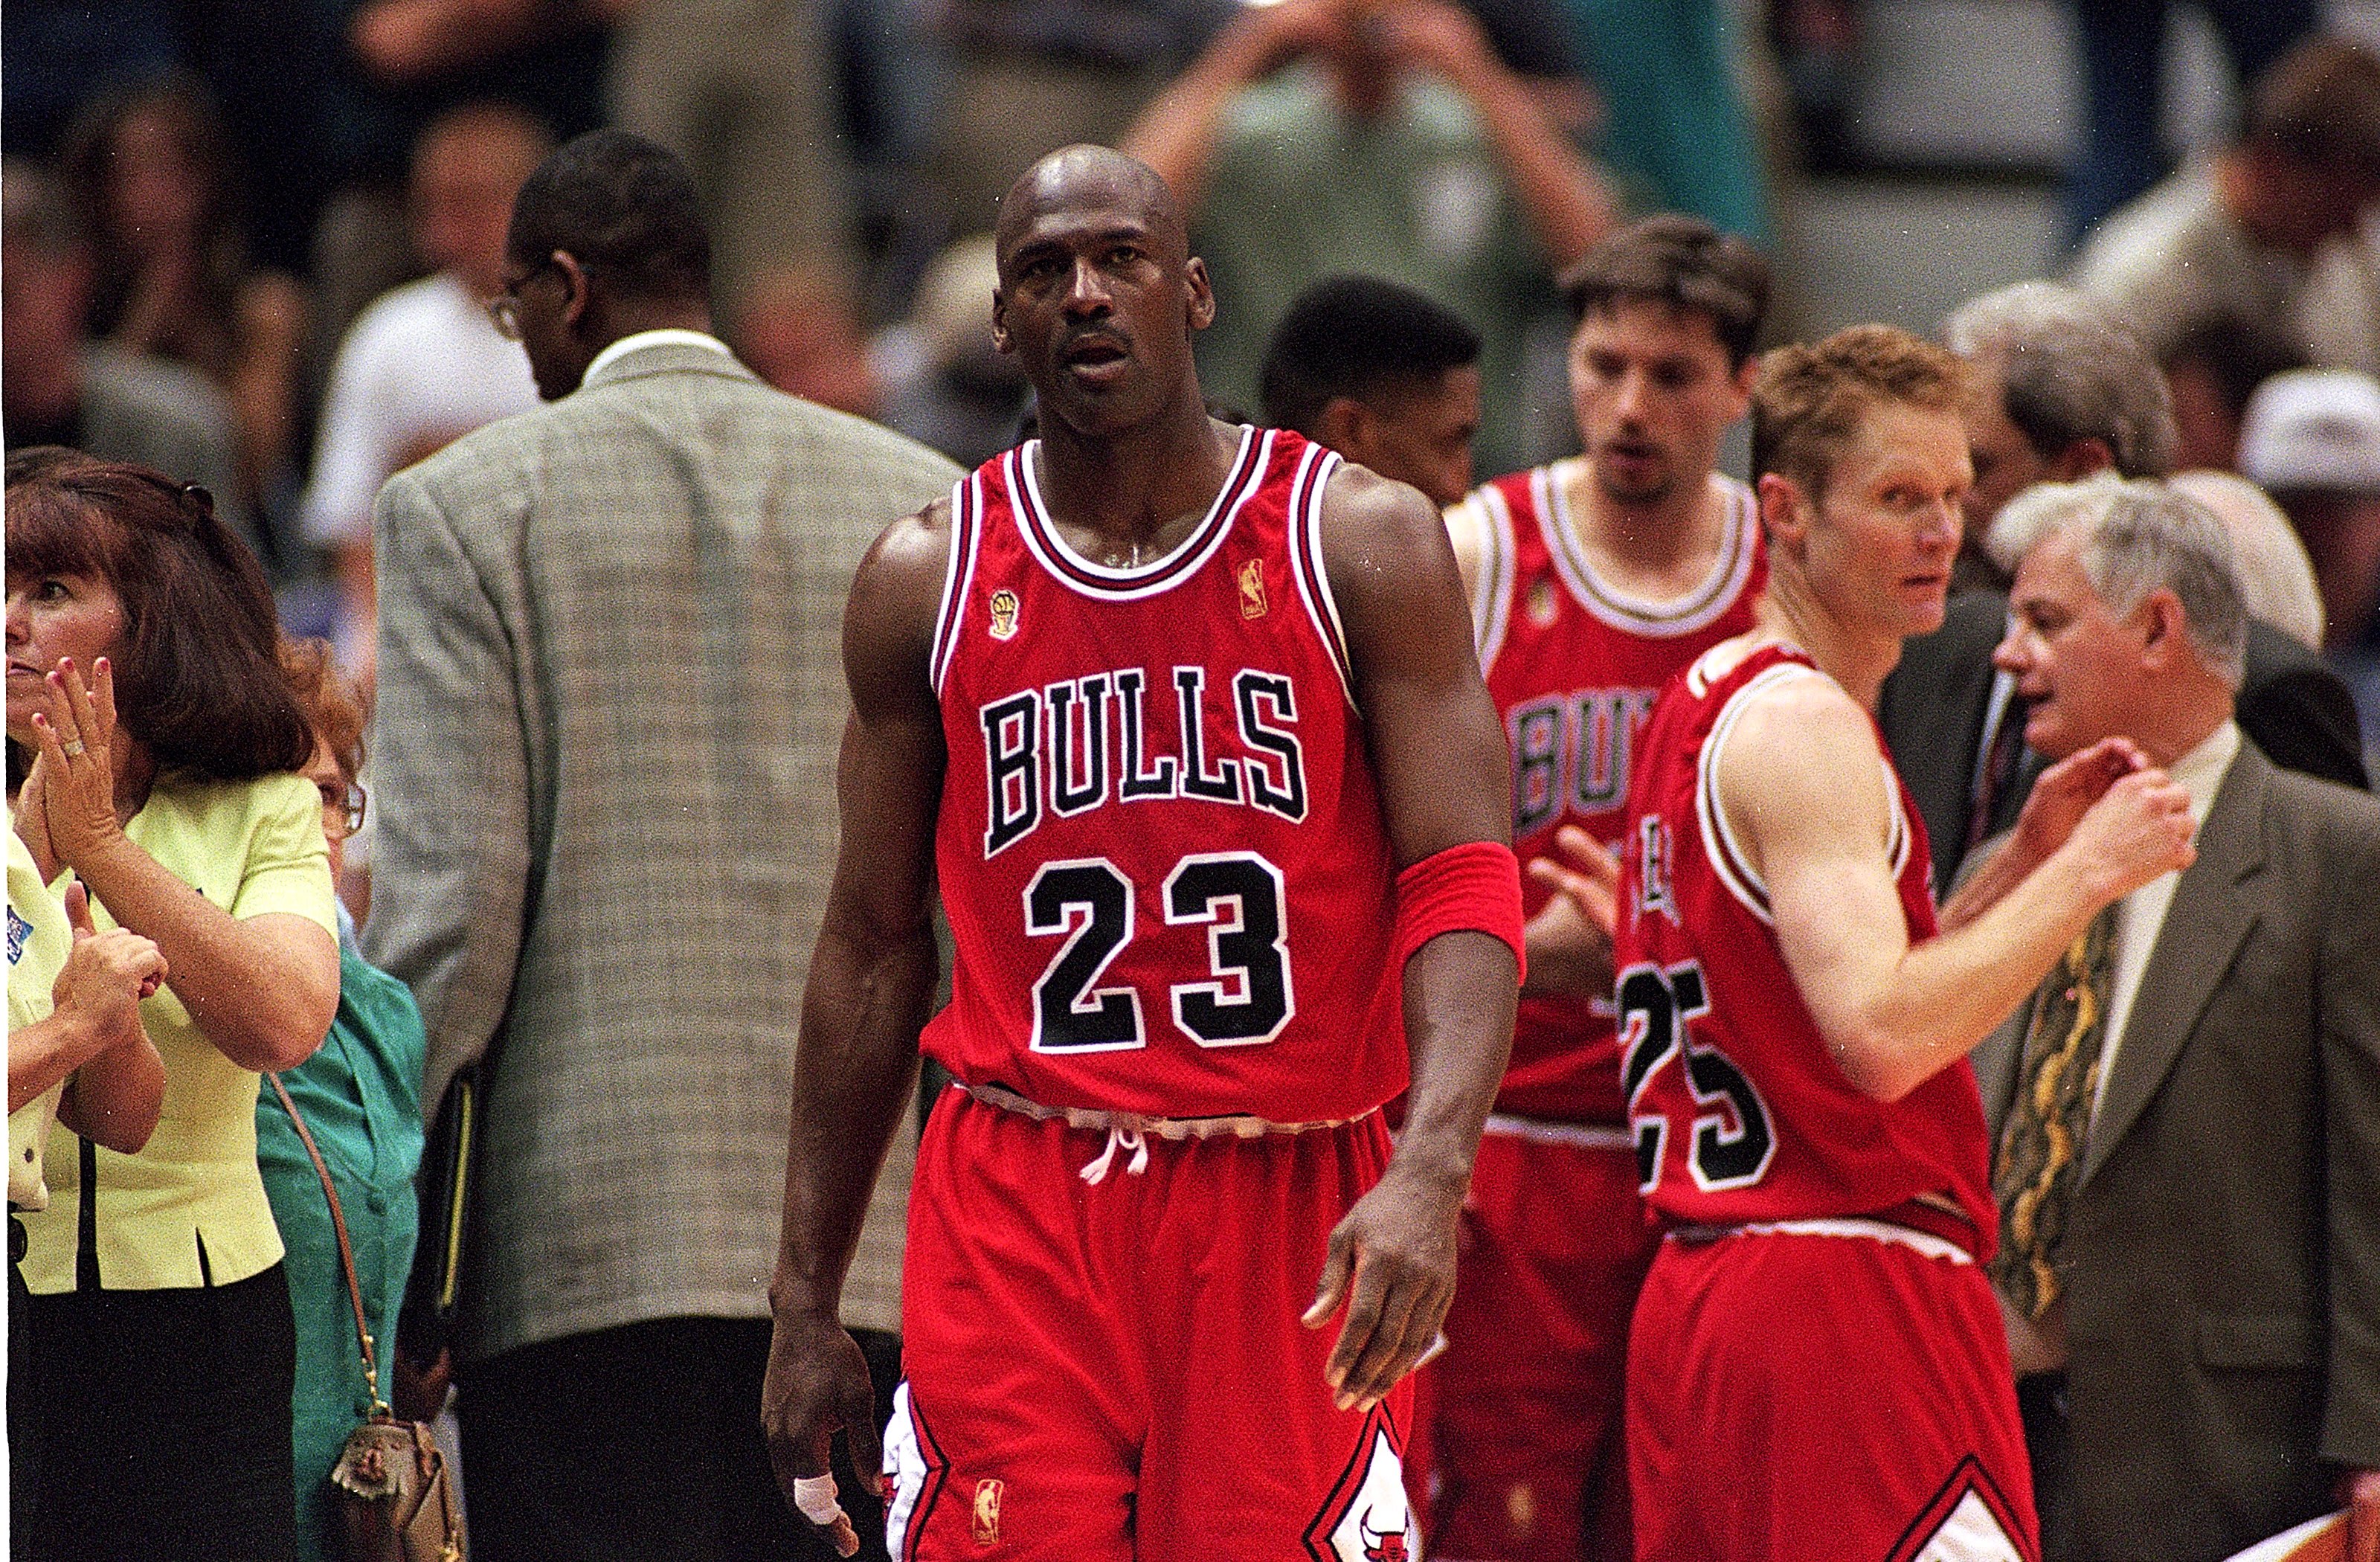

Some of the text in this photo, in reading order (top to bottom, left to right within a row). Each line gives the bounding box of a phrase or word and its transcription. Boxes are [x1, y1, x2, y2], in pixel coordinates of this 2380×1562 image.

[979, 666, 1308, 860] BULLS
[1506, 685, 1661, 842] BU
[1022, 850, 1296, 1054] 23
[1616, 960, 1778, 1193] 25
